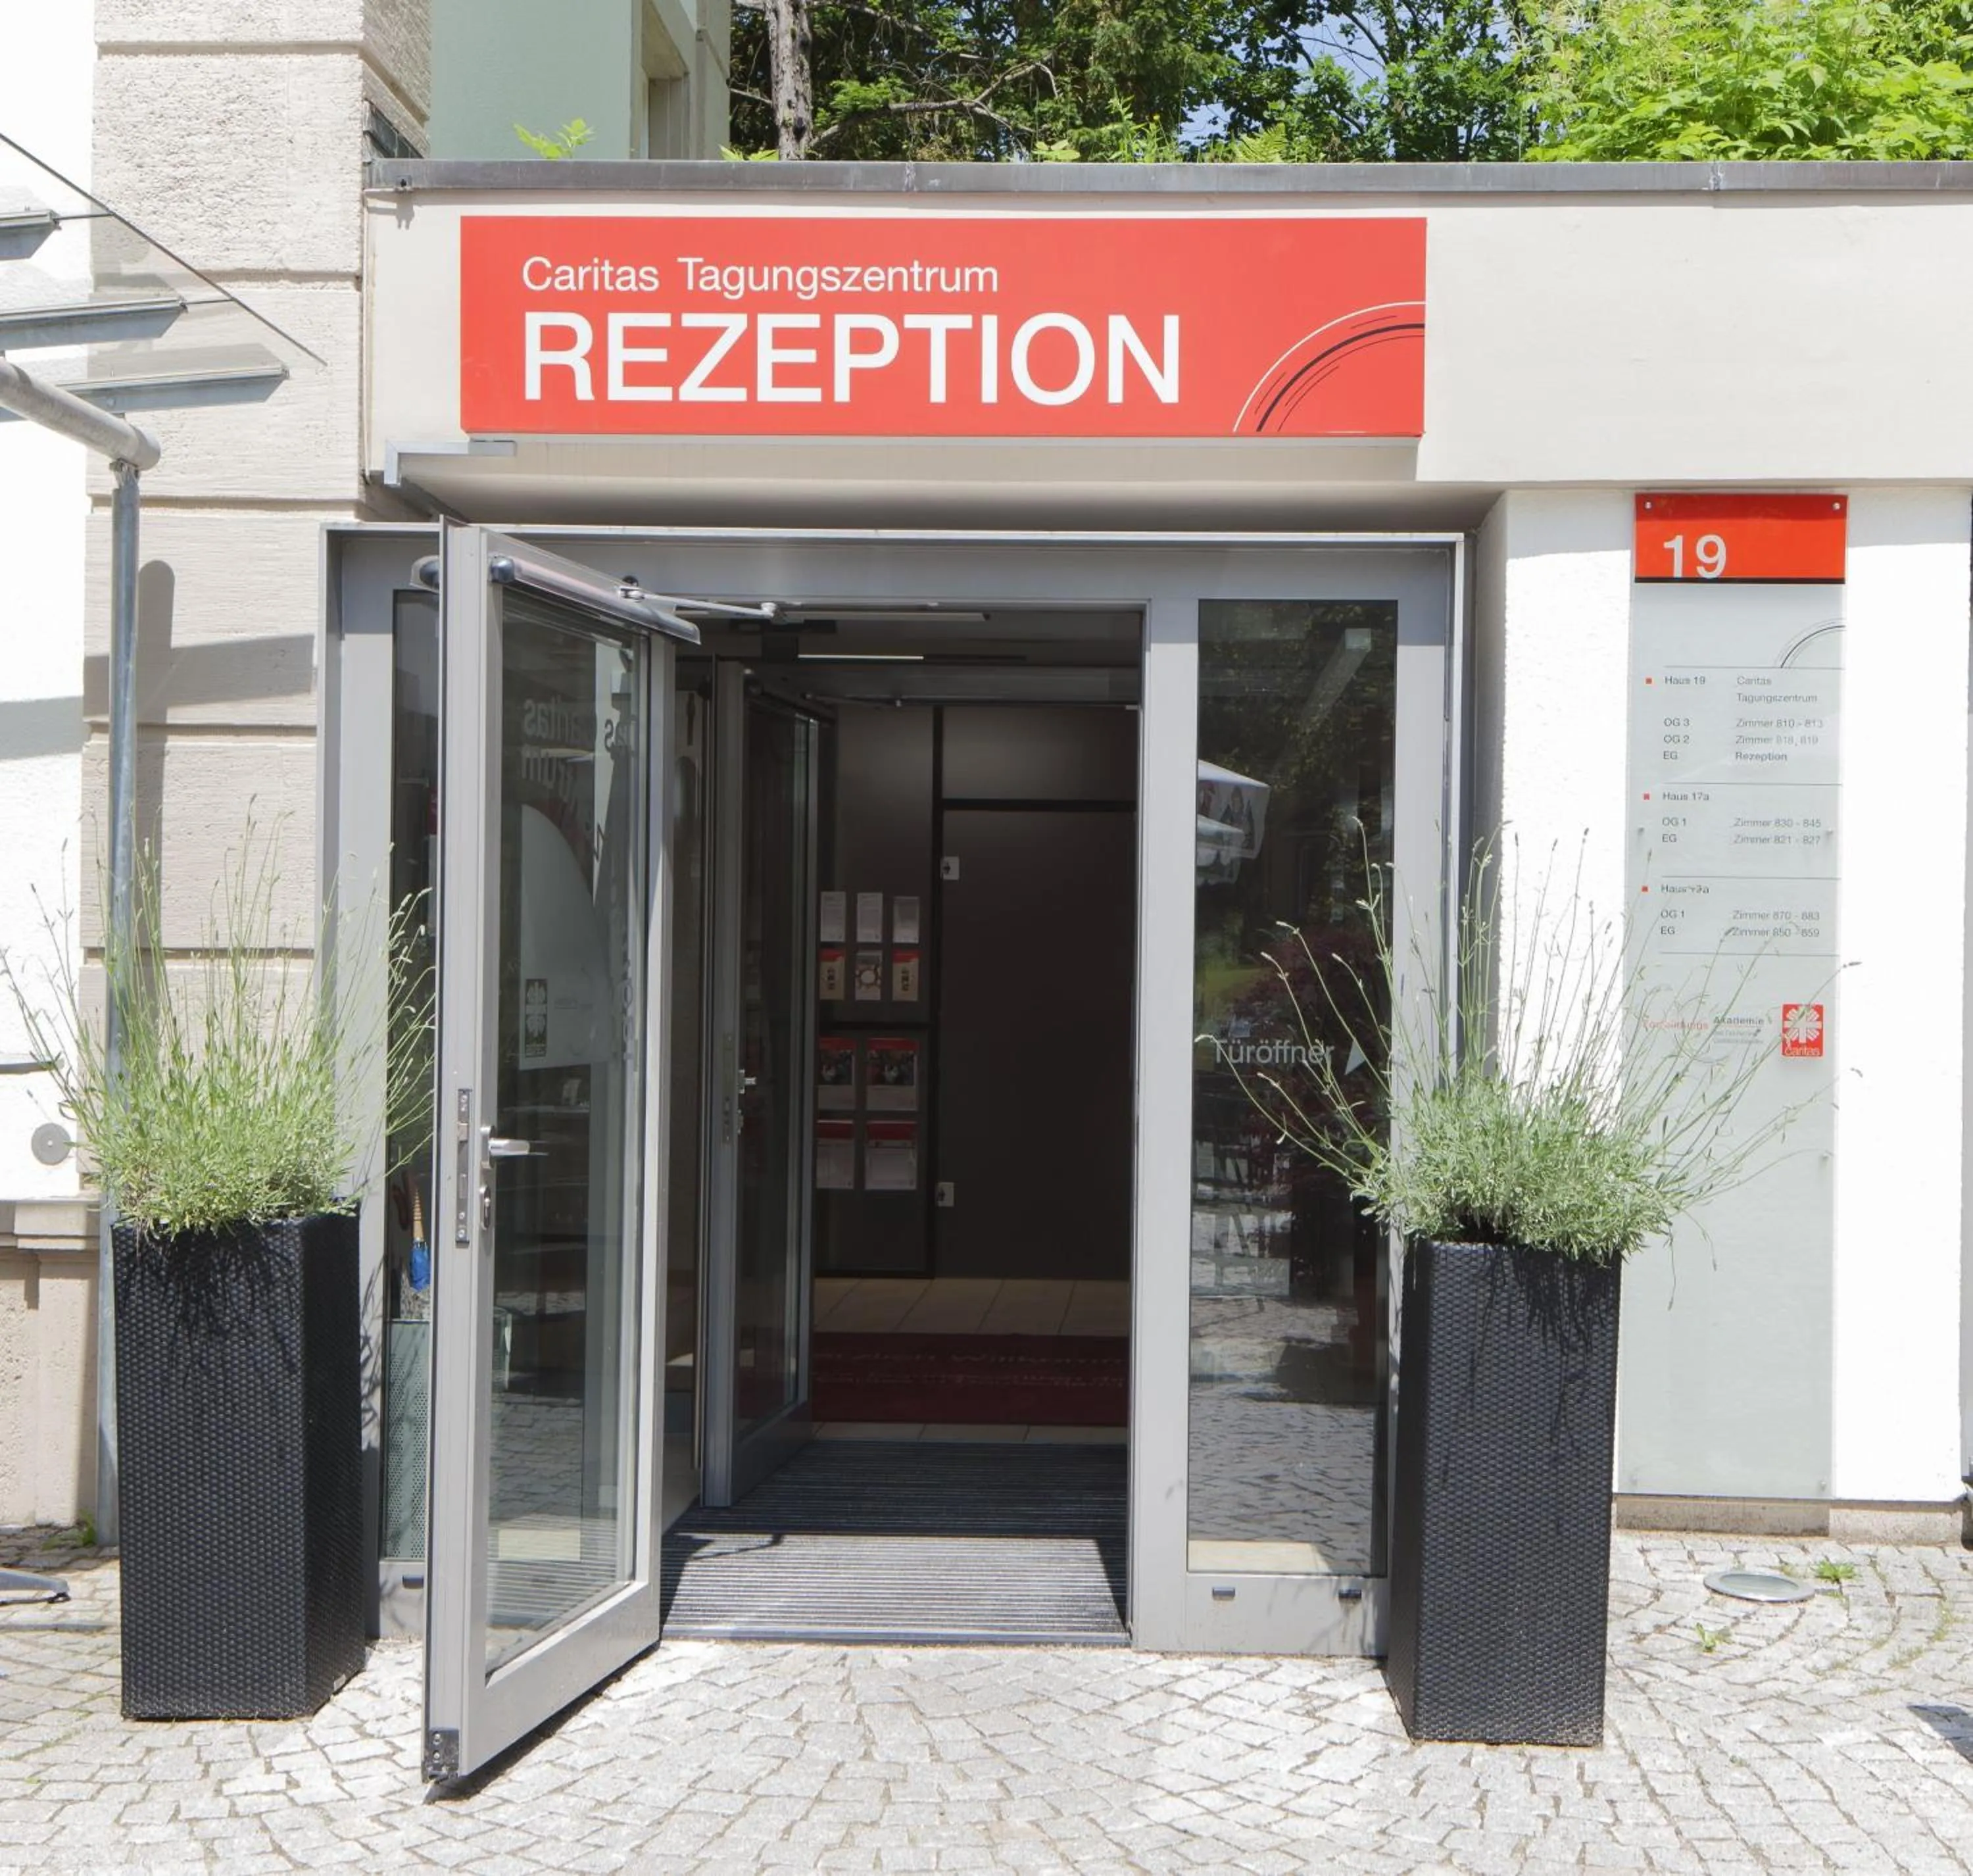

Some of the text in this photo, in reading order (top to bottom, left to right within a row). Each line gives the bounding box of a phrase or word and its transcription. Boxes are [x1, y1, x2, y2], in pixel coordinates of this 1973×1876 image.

[522, 256, 998, 299] Caritas Tagungszentrum
[524, 311, 1181, 405] REZEPTION
[1663, 533, 1727, 579] 19
[1665, 676, 1706, 685] Haus 19
[1737, 676, 1772, 685] Caritas
[1737, 693, 1818, 704] Tagungszentrum
[1664, 718, 1680, 727] OG
[1683, 718, 1690, 727] 3
[1736, 718, 1772, 728] Zimmer
[1664, 735, 1680, 744] OG
[1683, 735, 1690, 744] 2
[1736, 735, 1772, 745] Zimmer
[1663, 751, 1787, 762] EG Rezeption
[1662, 792, 1709, 801] Haus 17a
[1662, 817, 1679, 826] OG
[1682, 817, 1687, 826] 1
[1734, 817, 1772, 827] Zimmer
[1662, 834, 1677, 843] EG
[1734, 834, 1770, 844] Zimmer
[1661, 884, 1687, 893] Haus
[1661, 910, 1677, 918] OG
[1680, 910, 1685, 918] 1
[1732, 910, 1770, 920] Zimmer
[1661, 926, 1675, 935] EG
[1732, 927, 1770, 936] Zimmer
[1214, 1038, 1334, 1064] Türöffner
